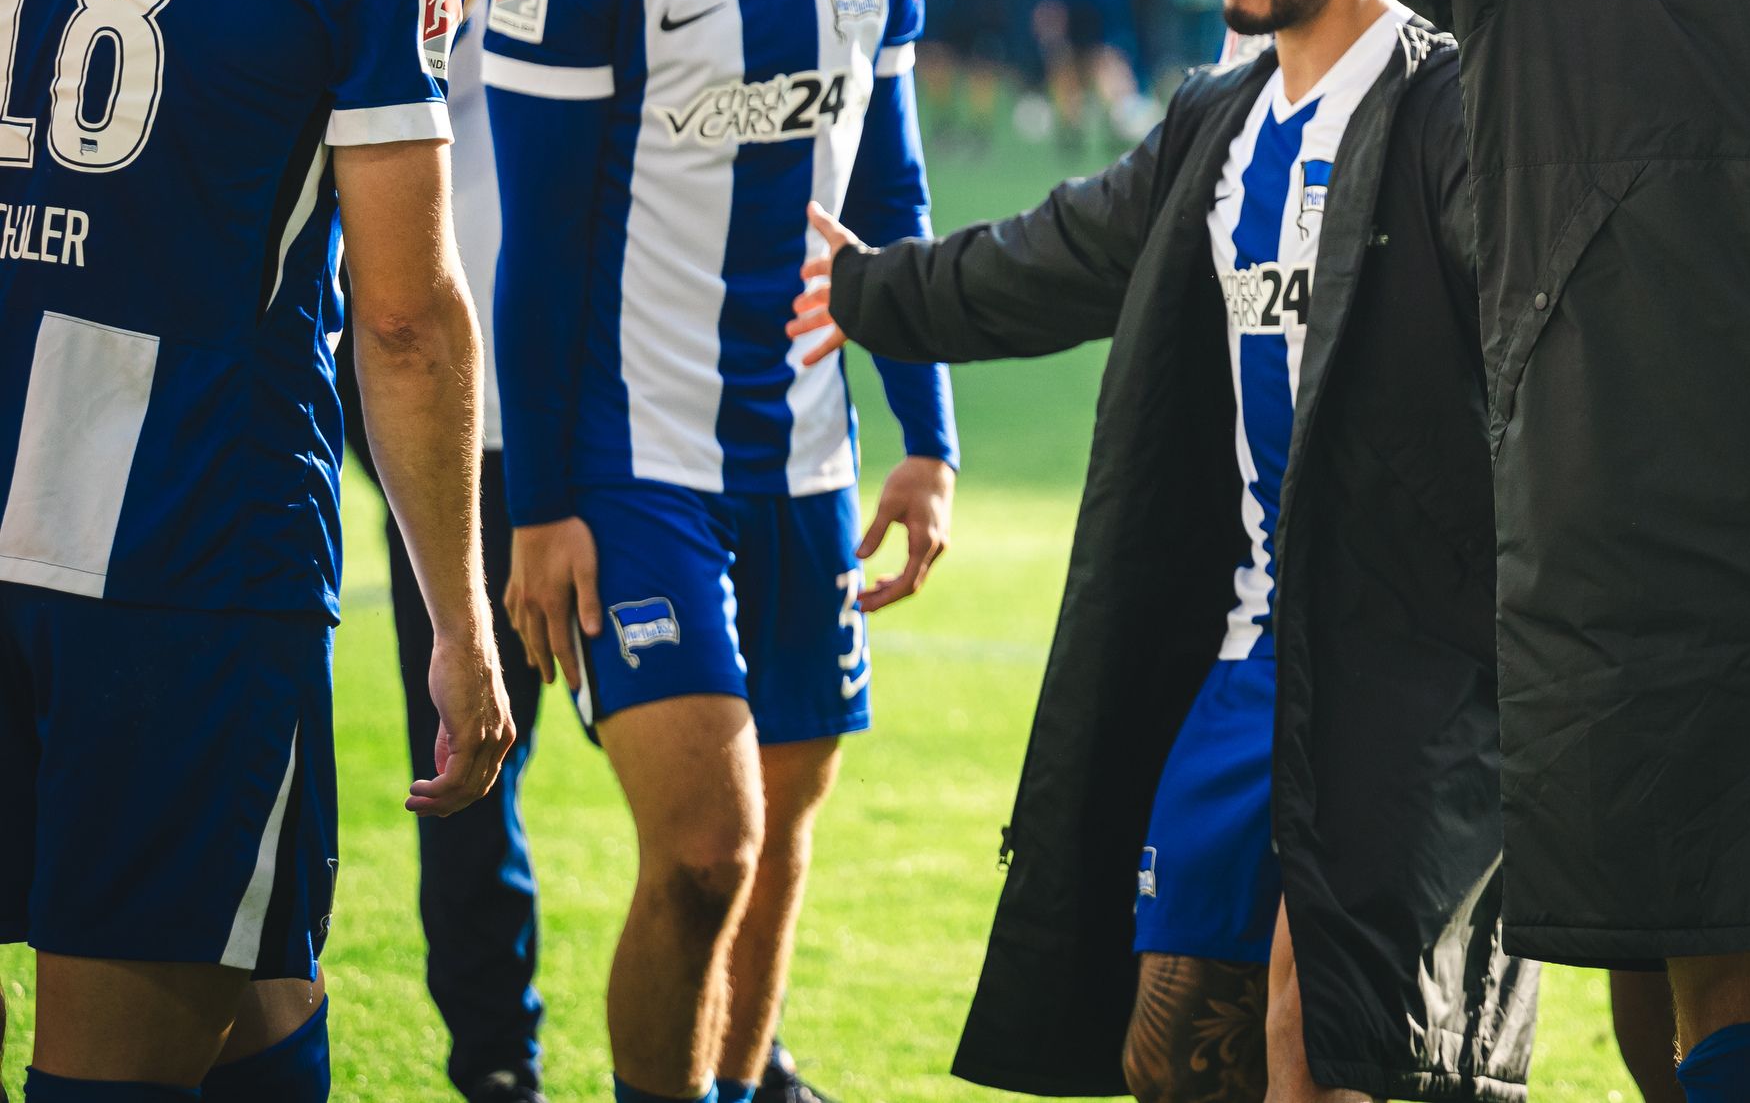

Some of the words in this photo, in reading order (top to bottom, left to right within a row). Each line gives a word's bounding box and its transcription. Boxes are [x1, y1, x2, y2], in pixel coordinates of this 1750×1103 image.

[700, 107, 776, 138] CARS
[715, 81, 787, 115] check
[780, 74, 847, 133] 24
[0, 203, 90, 268] HULER
[1260, 269, 1310, 326] 24
